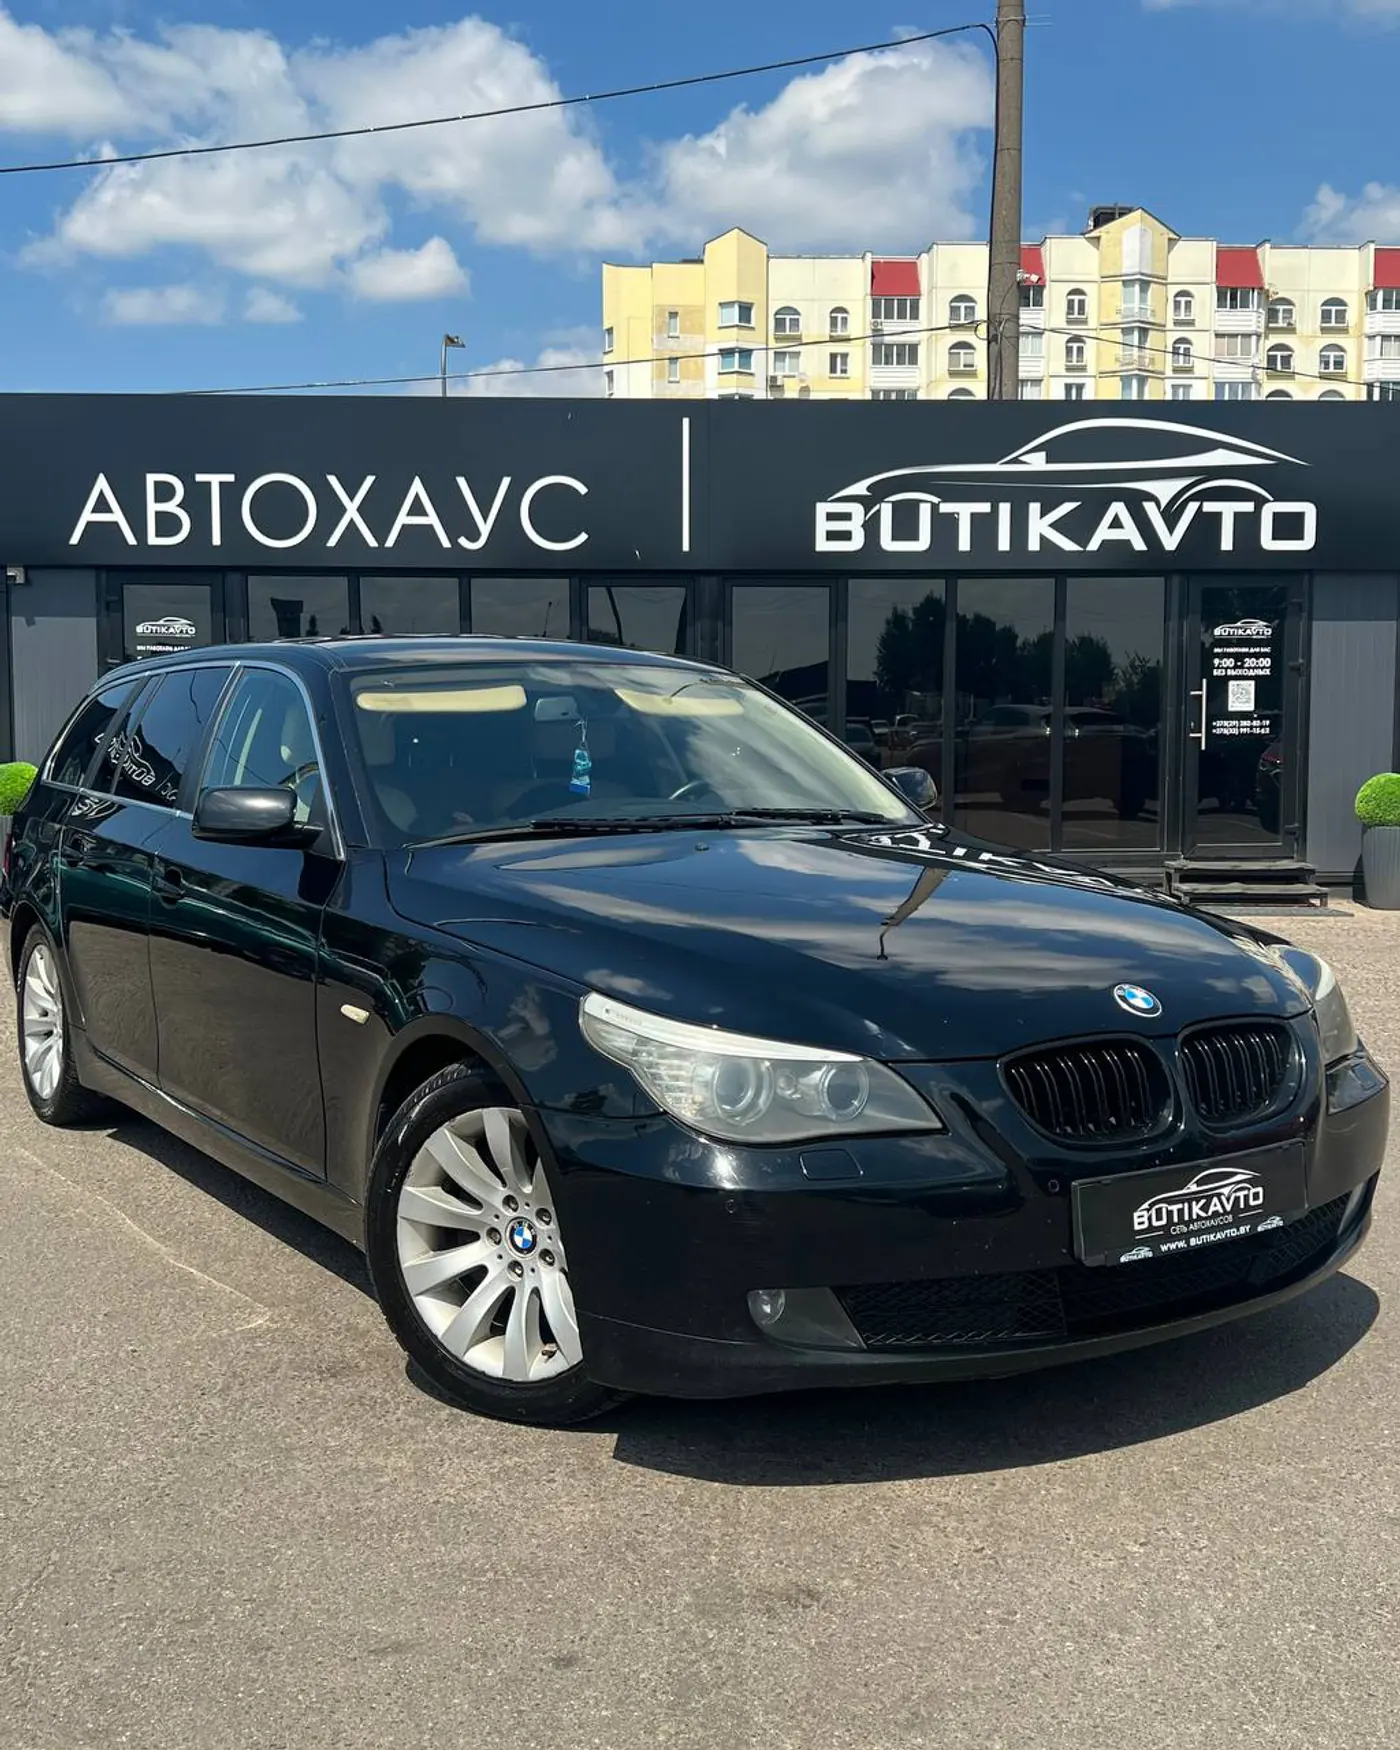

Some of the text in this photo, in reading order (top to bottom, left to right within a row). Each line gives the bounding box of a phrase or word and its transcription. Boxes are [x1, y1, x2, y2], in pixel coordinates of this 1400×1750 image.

[69, 472, 589, 551] АВТОХАУС
[814, 500, 1317, 552] BUTIKAVTO
[1213, 627, 1272, 637] BUTIKAVTO
[1212, 668, 1271, 677] БЕЗ ВЫХОДНЫХ
[1213, 657, 1235, 668] 9:00
[1243, 657, 1272, 668] 20:00
[1133, 1186, 1264, 1231] BUTIKAVTO
[1170, 1214, 1234, 1235] СЕТЬ АВТОХАУСОВ
[1189, 1225, 1251, 1247] BUTIKAVTO.BY
